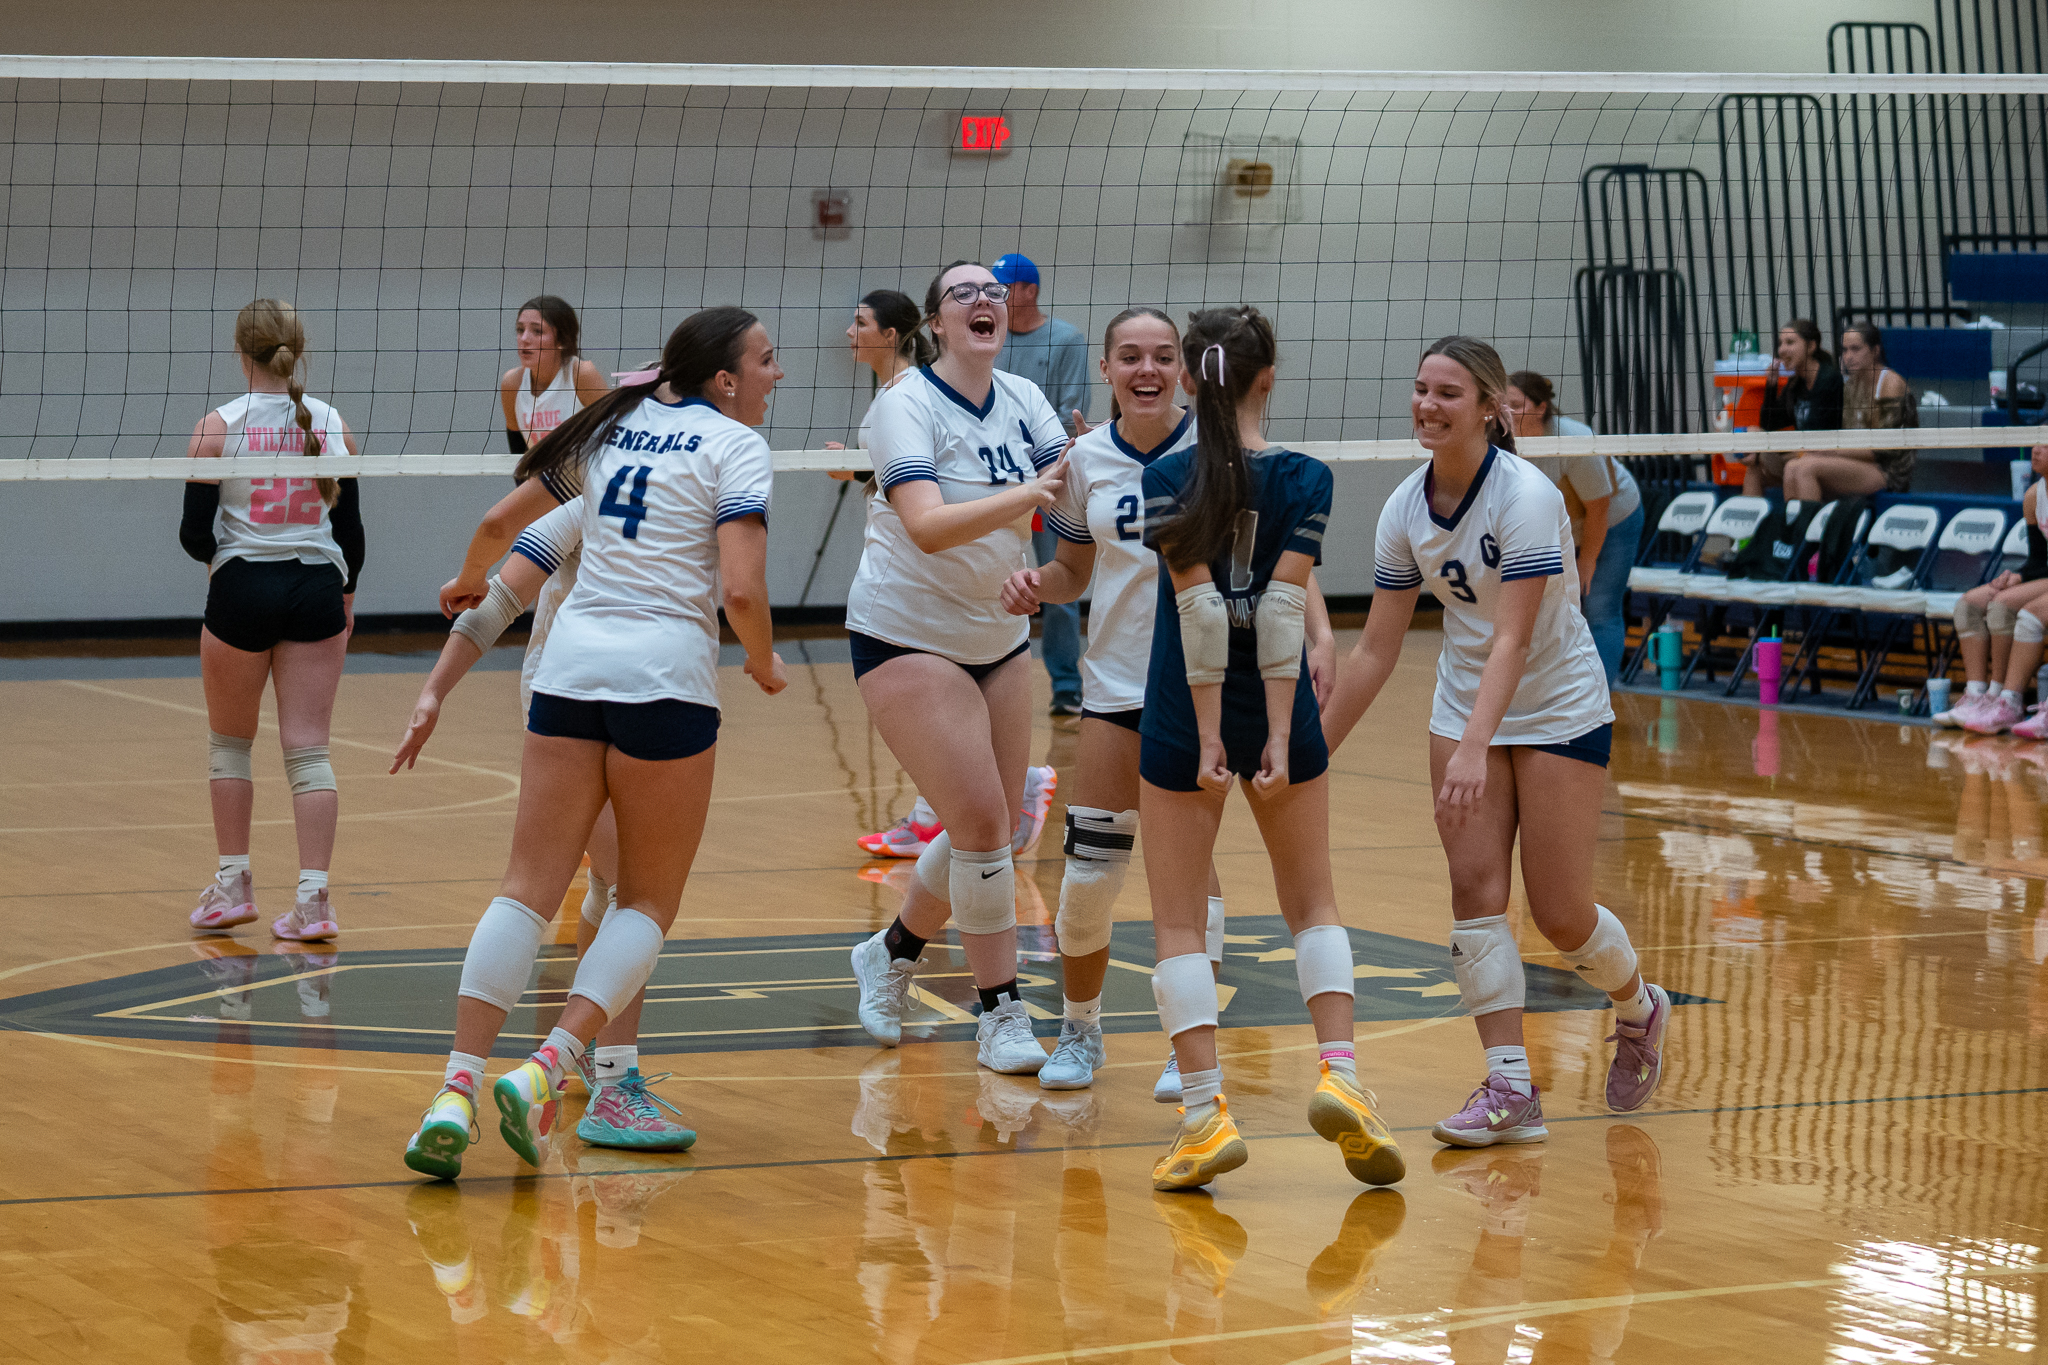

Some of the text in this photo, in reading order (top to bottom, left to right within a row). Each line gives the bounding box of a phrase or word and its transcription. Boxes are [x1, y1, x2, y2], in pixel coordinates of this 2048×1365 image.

[962, 116, 1004, 150] EXIT
[979, 444, 1025, 485] 24
[249, 478, 323, 525] 22
[598, 465, 654, 540] 4
[1230, 508, 1259, 592] 1
[1479, 532, 1501, 569] G
[1440, 559, 1477, 603] 3
